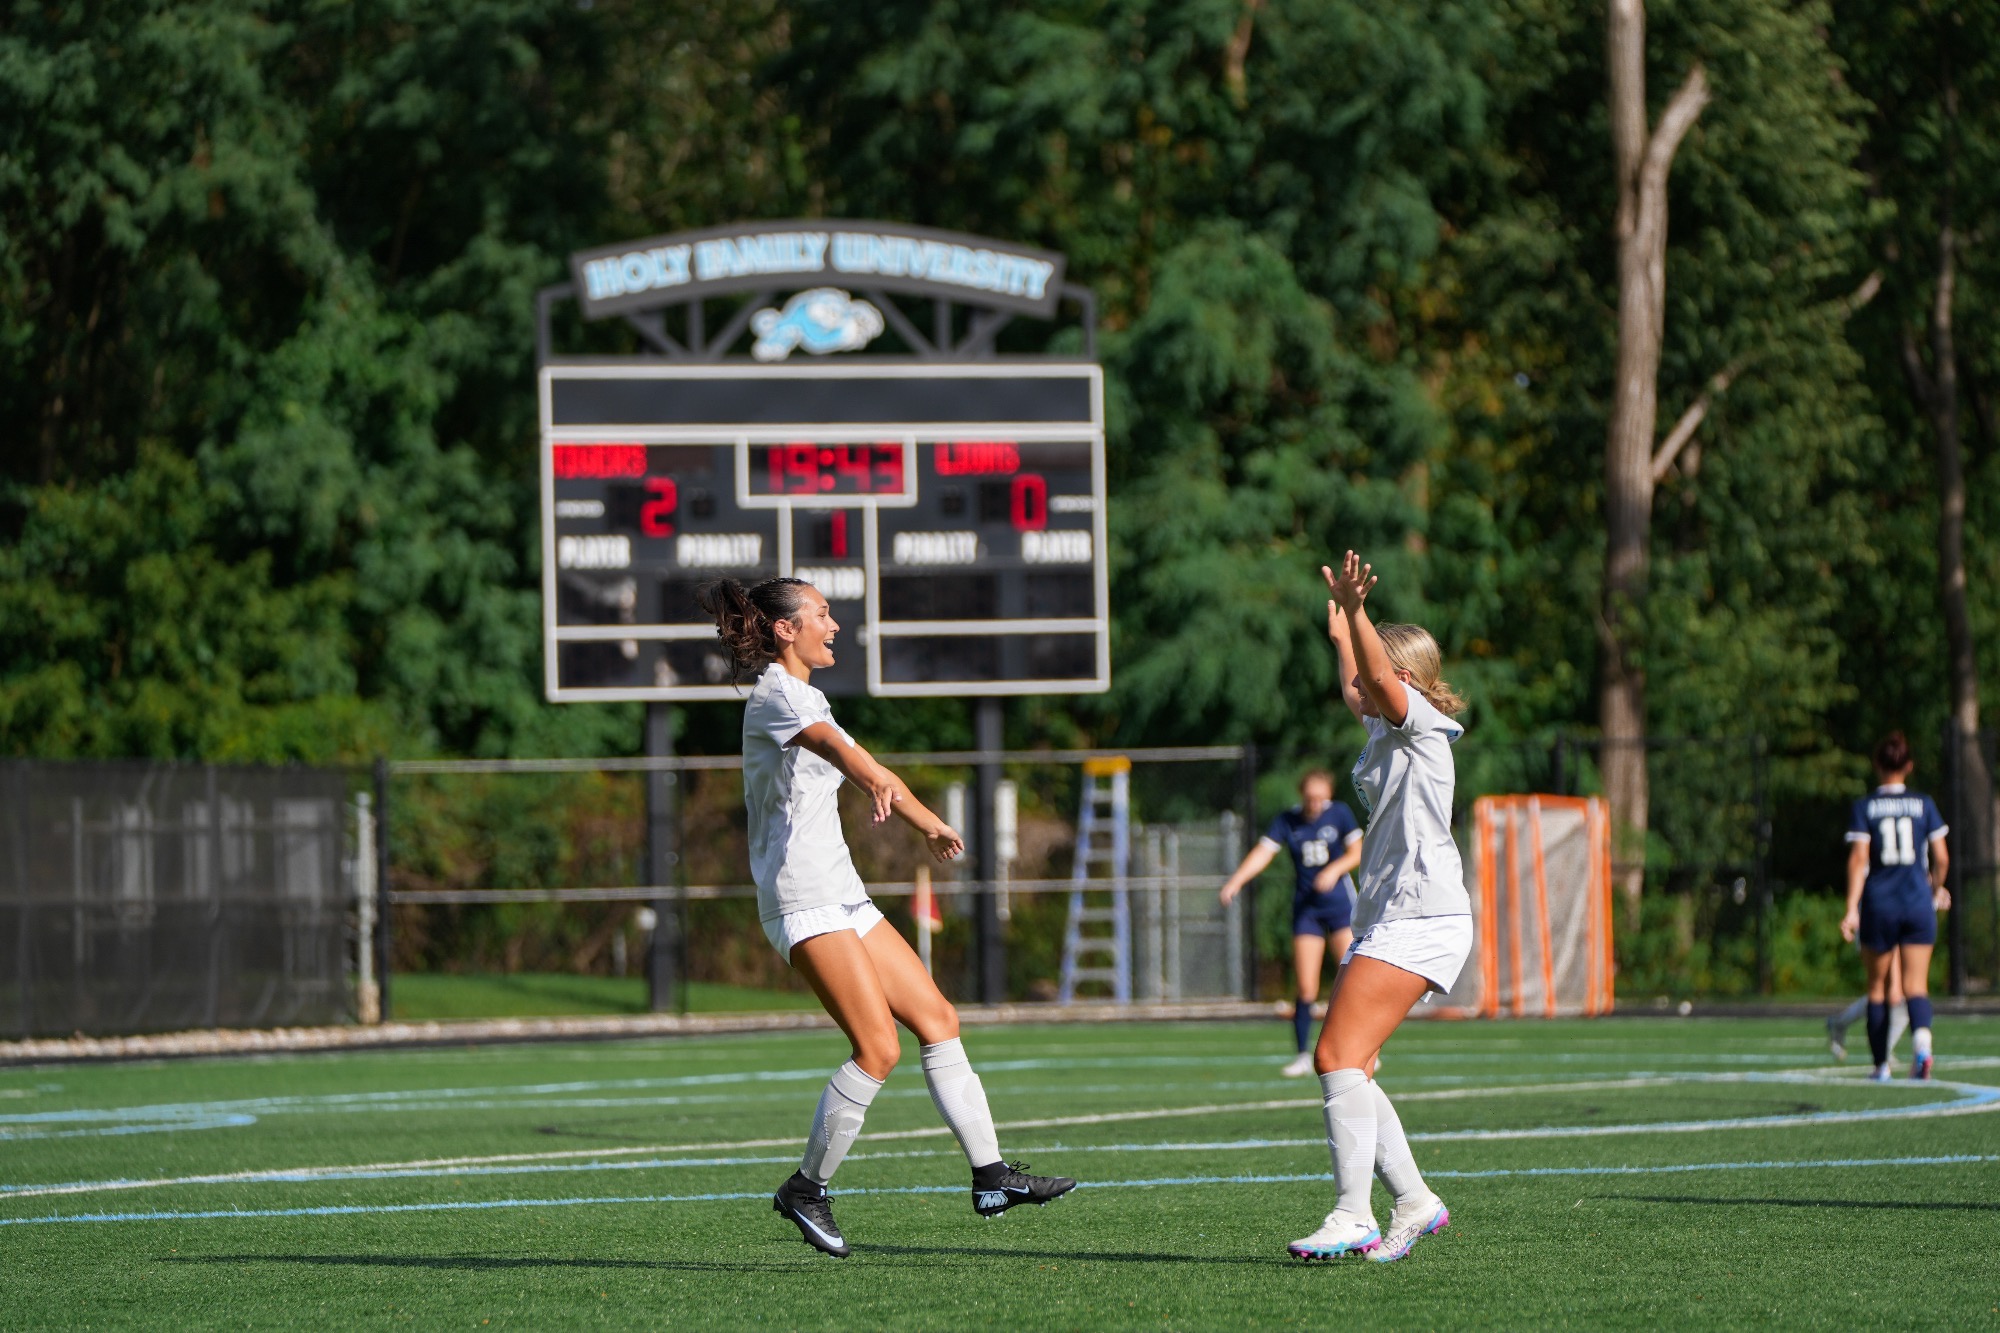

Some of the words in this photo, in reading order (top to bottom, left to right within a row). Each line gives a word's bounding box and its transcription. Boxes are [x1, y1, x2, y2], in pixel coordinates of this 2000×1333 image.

[583, 245, 692, 299] HOLY
[693, 232, 830, 281] FAMILY
[830, 232, 1054, 300] UNIVERSITY
[768, 441, 905, 495] 19:43
[641, 476, 678, 538] 2
[1010, 473, 1047, 533] 0
[831, 507, 847, 561] 1
[1879, 816, 1916, 866] 11
